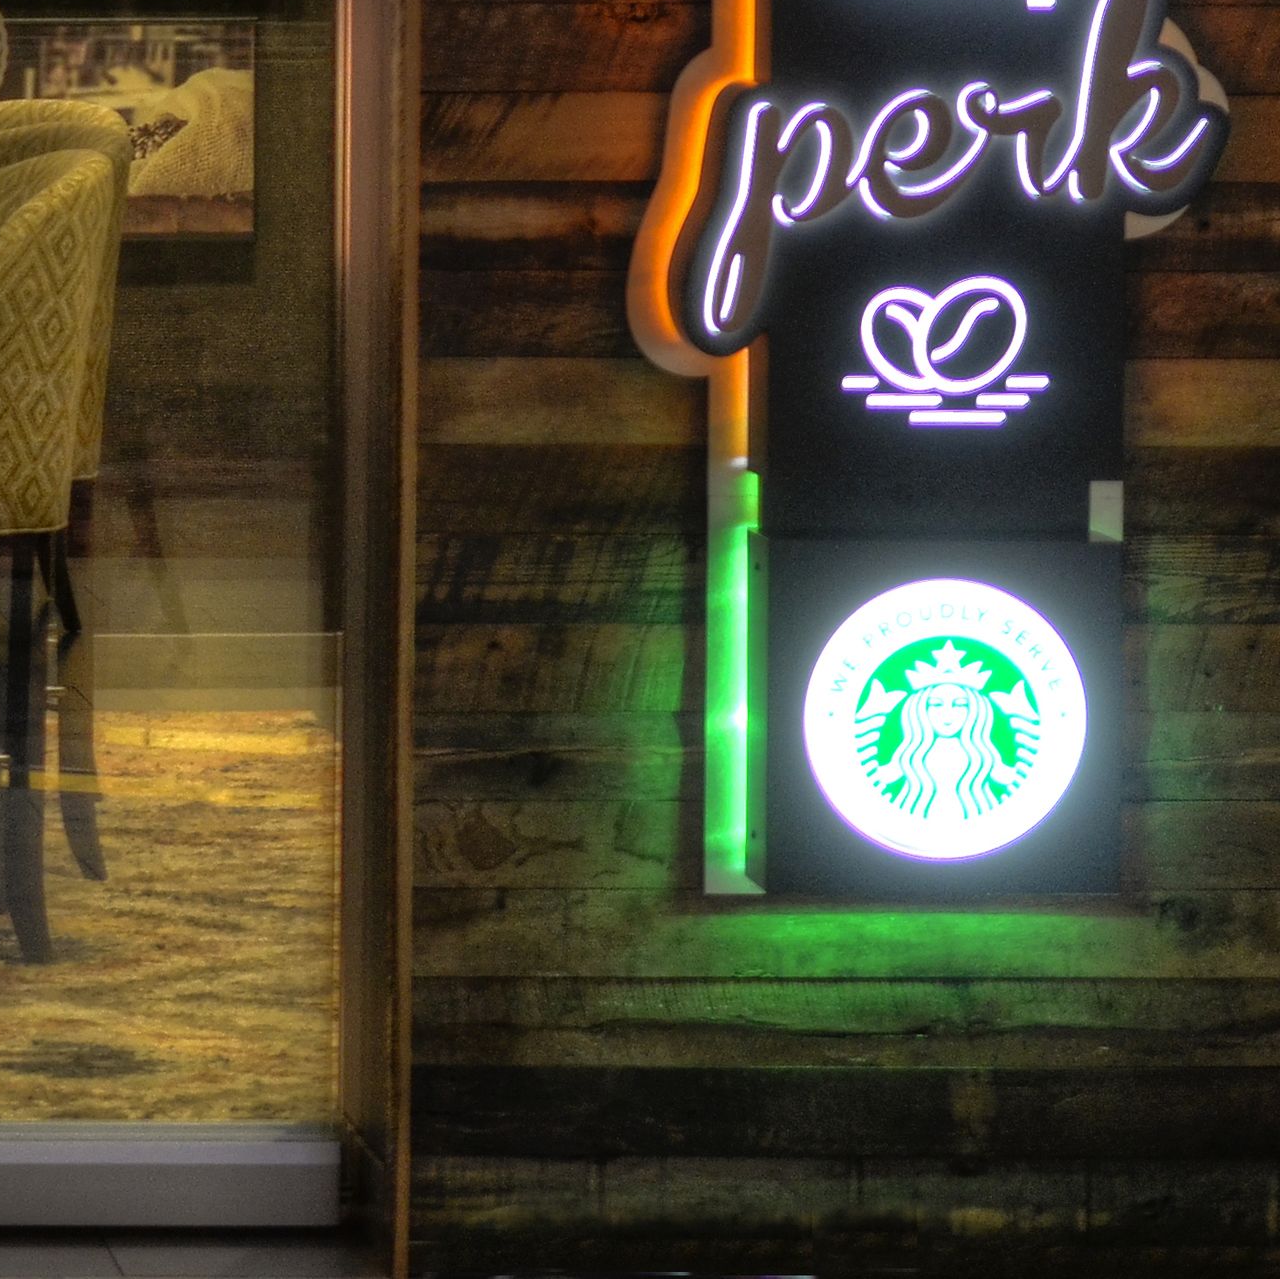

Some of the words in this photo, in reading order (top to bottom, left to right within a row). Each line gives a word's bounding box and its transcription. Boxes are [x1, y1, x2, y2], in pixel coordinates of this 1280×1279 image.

[829, 657, 859, 694] WE
[861, 602, 990, 649] PROUDLY
[1000, 618, 1063, 692] SERVE
